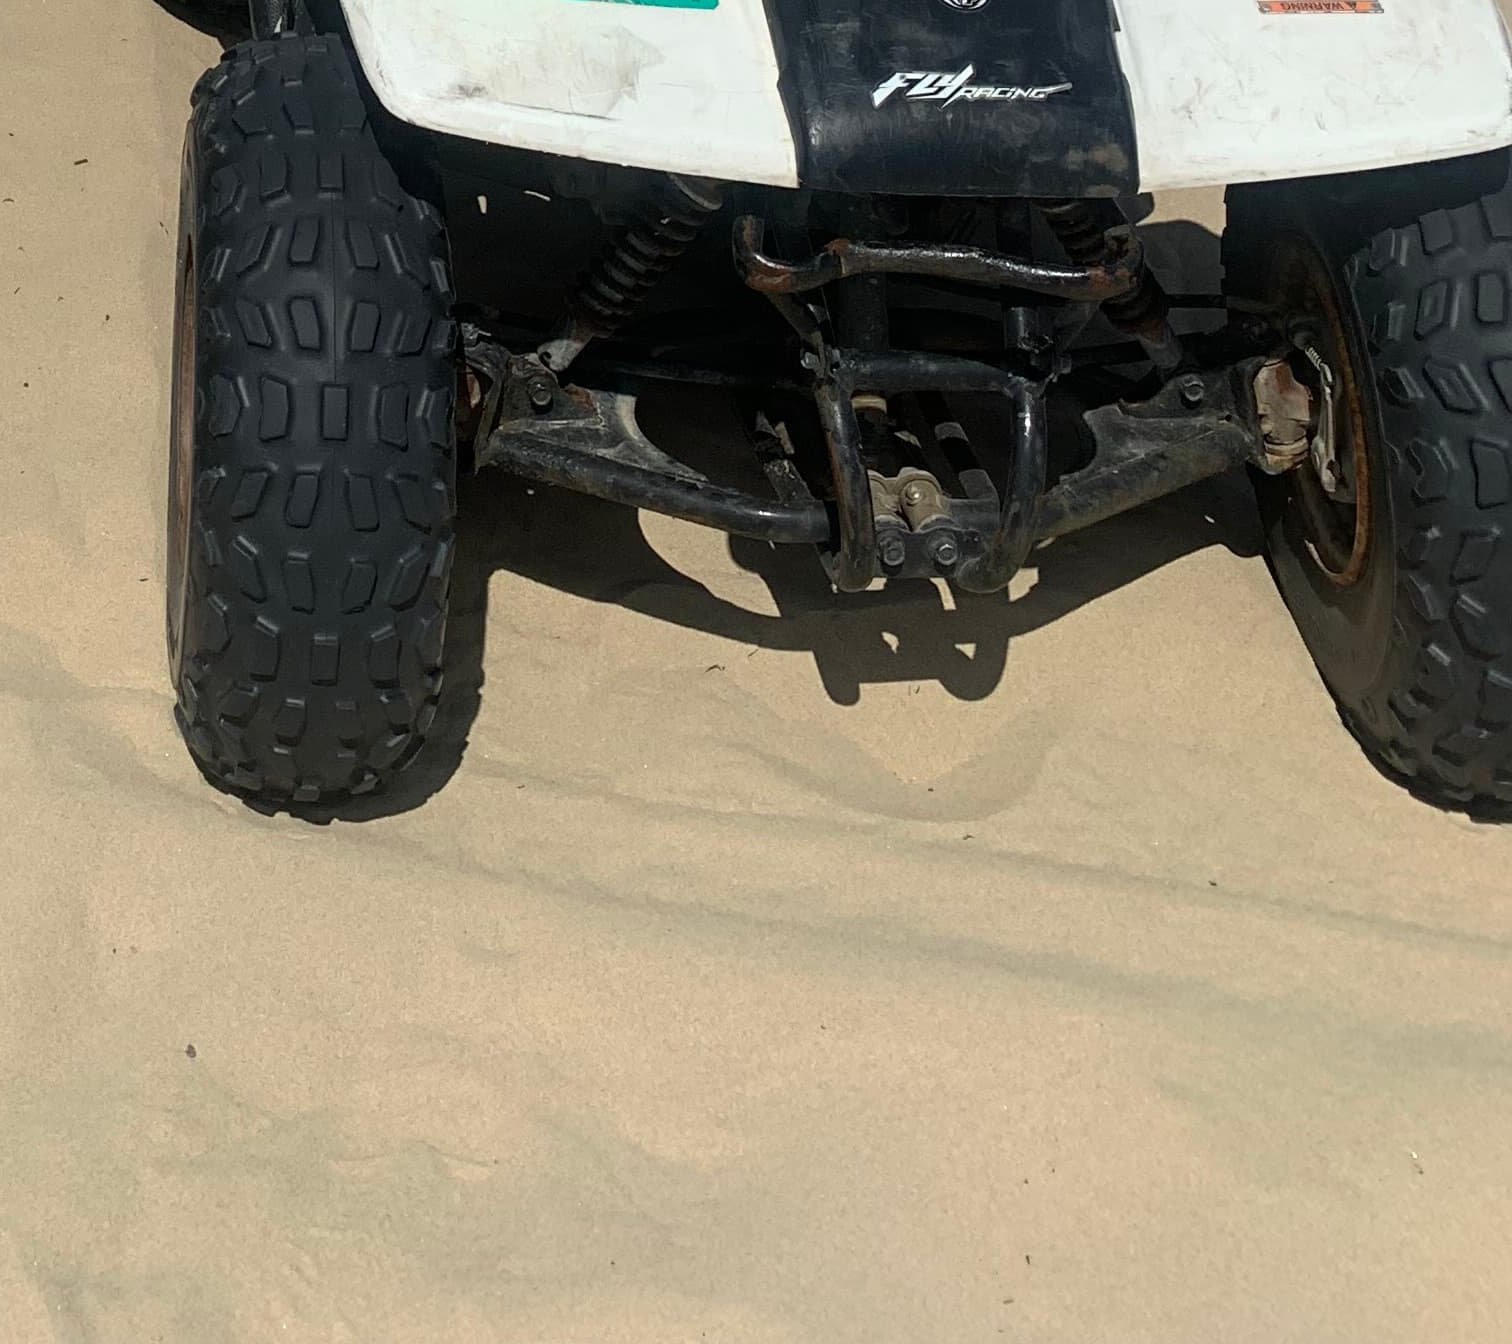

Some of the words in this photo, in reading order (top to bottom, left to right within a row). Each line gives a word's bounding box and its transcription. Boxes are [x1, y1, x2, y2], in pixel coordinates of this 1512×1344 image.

[1280, 1, 1345, 12] WARNING
[871, 64, 974, 110] FLY
[958, 82, 1072, 102] RACING
